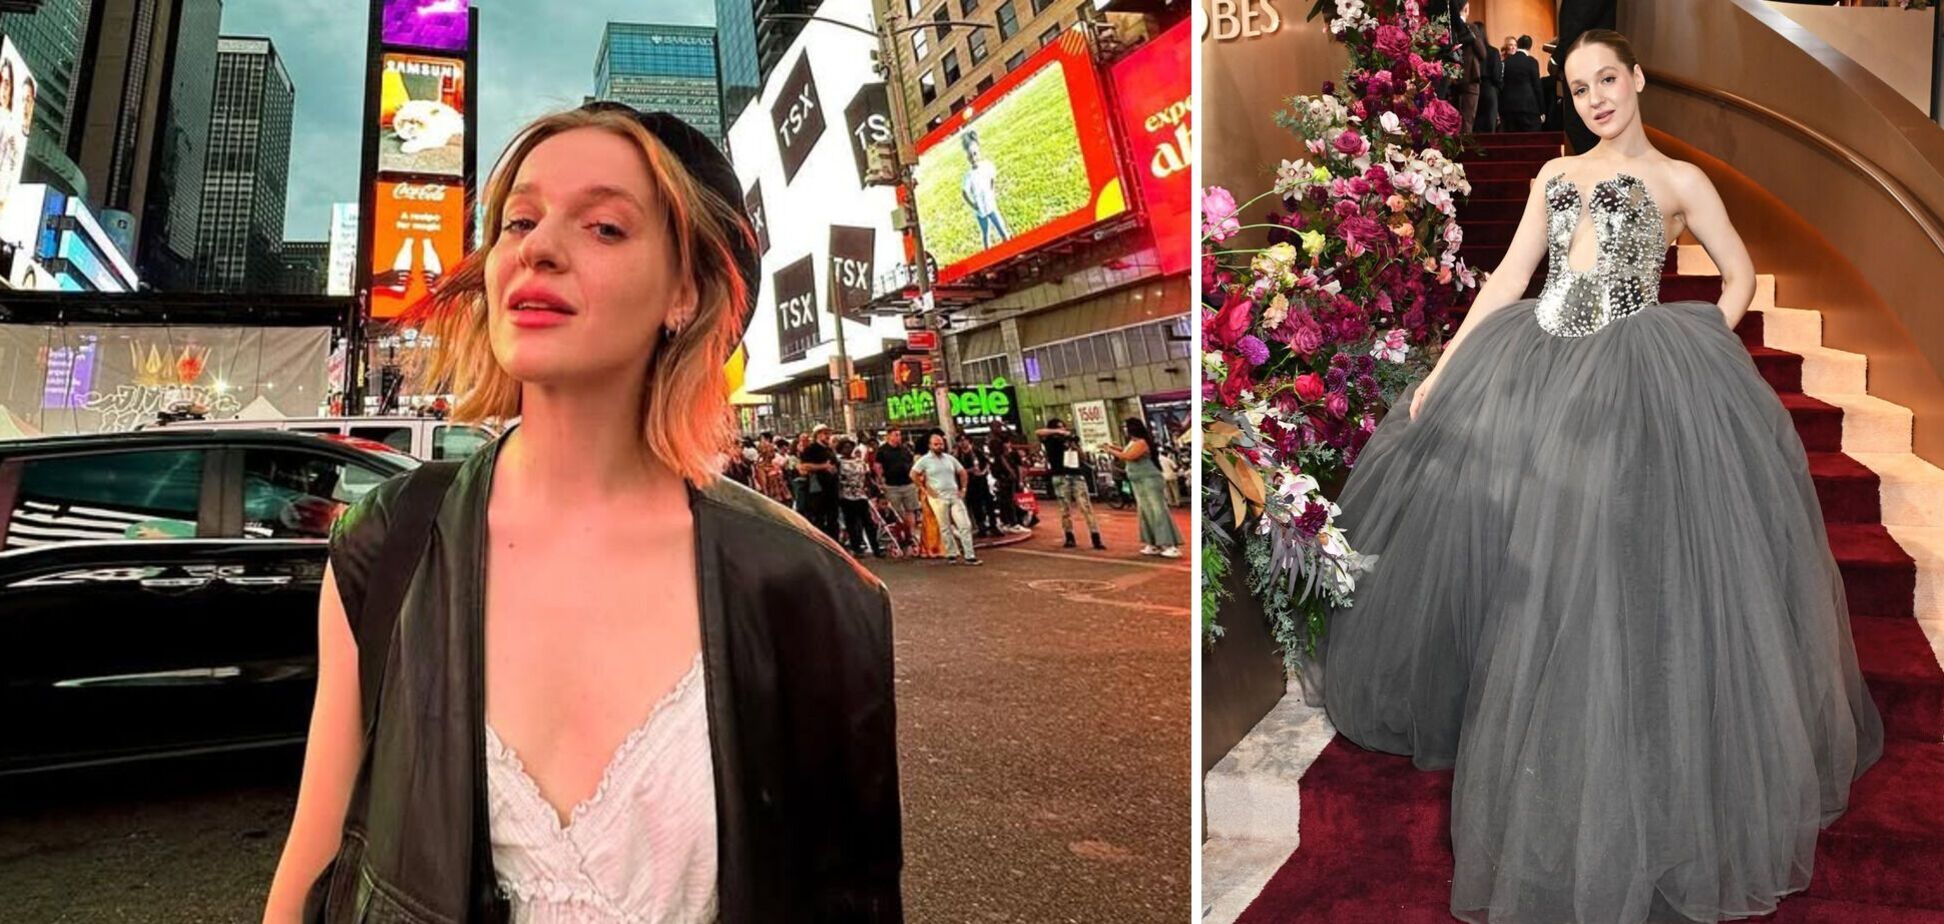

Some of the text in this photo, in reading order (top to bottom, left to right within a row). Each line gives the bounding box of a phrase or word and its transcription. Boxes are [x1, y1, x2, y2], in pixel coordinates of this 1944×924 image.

[780, 83, 814, 147] TSX
[854, 113, 893, 151] TS
[833, 257, 868, 290] TSX
[780, 292, 814, 330] TSX
